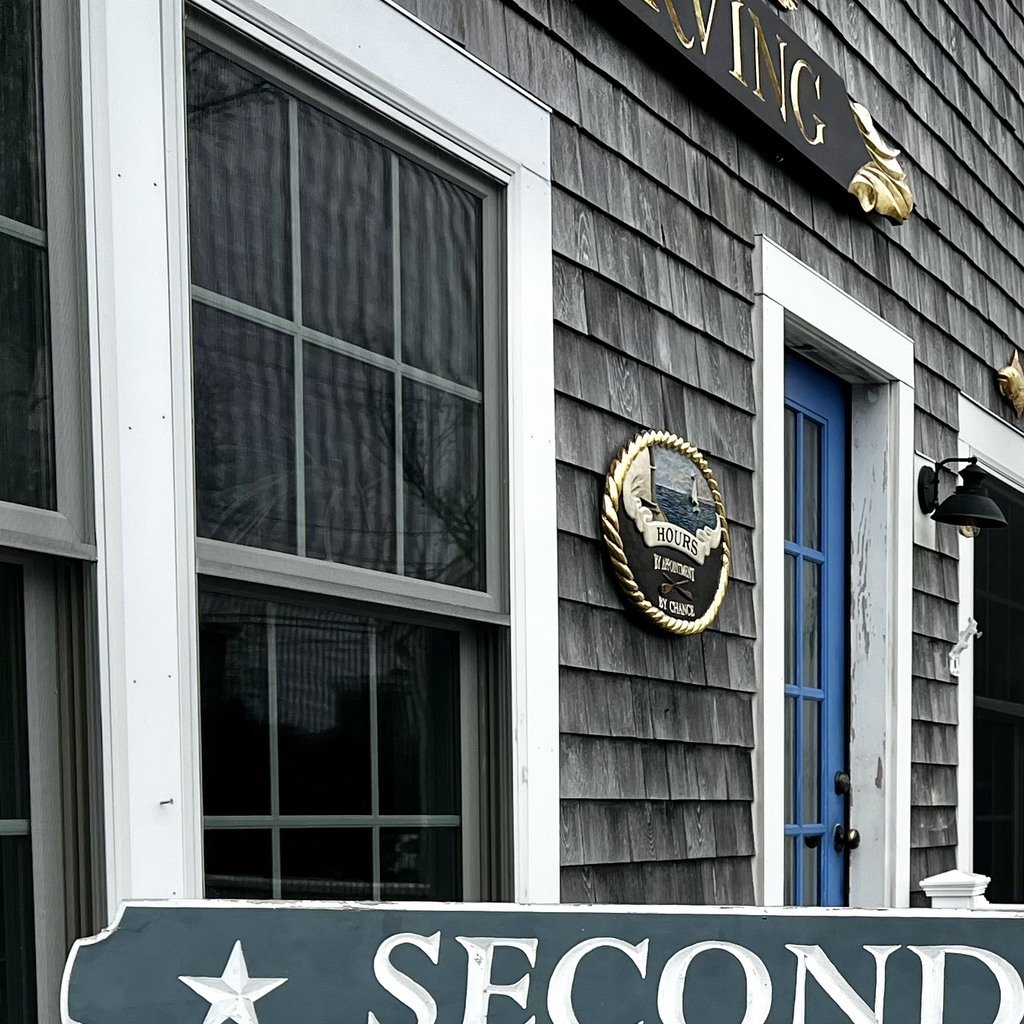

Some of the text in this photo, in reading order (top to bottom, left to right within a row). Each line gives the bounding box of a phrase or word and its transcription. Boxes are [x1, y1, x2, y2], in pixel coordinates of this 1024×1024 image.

[657, 527, 698, 556] HOURS
[658, 595, 696, 617] BY CHANCE
